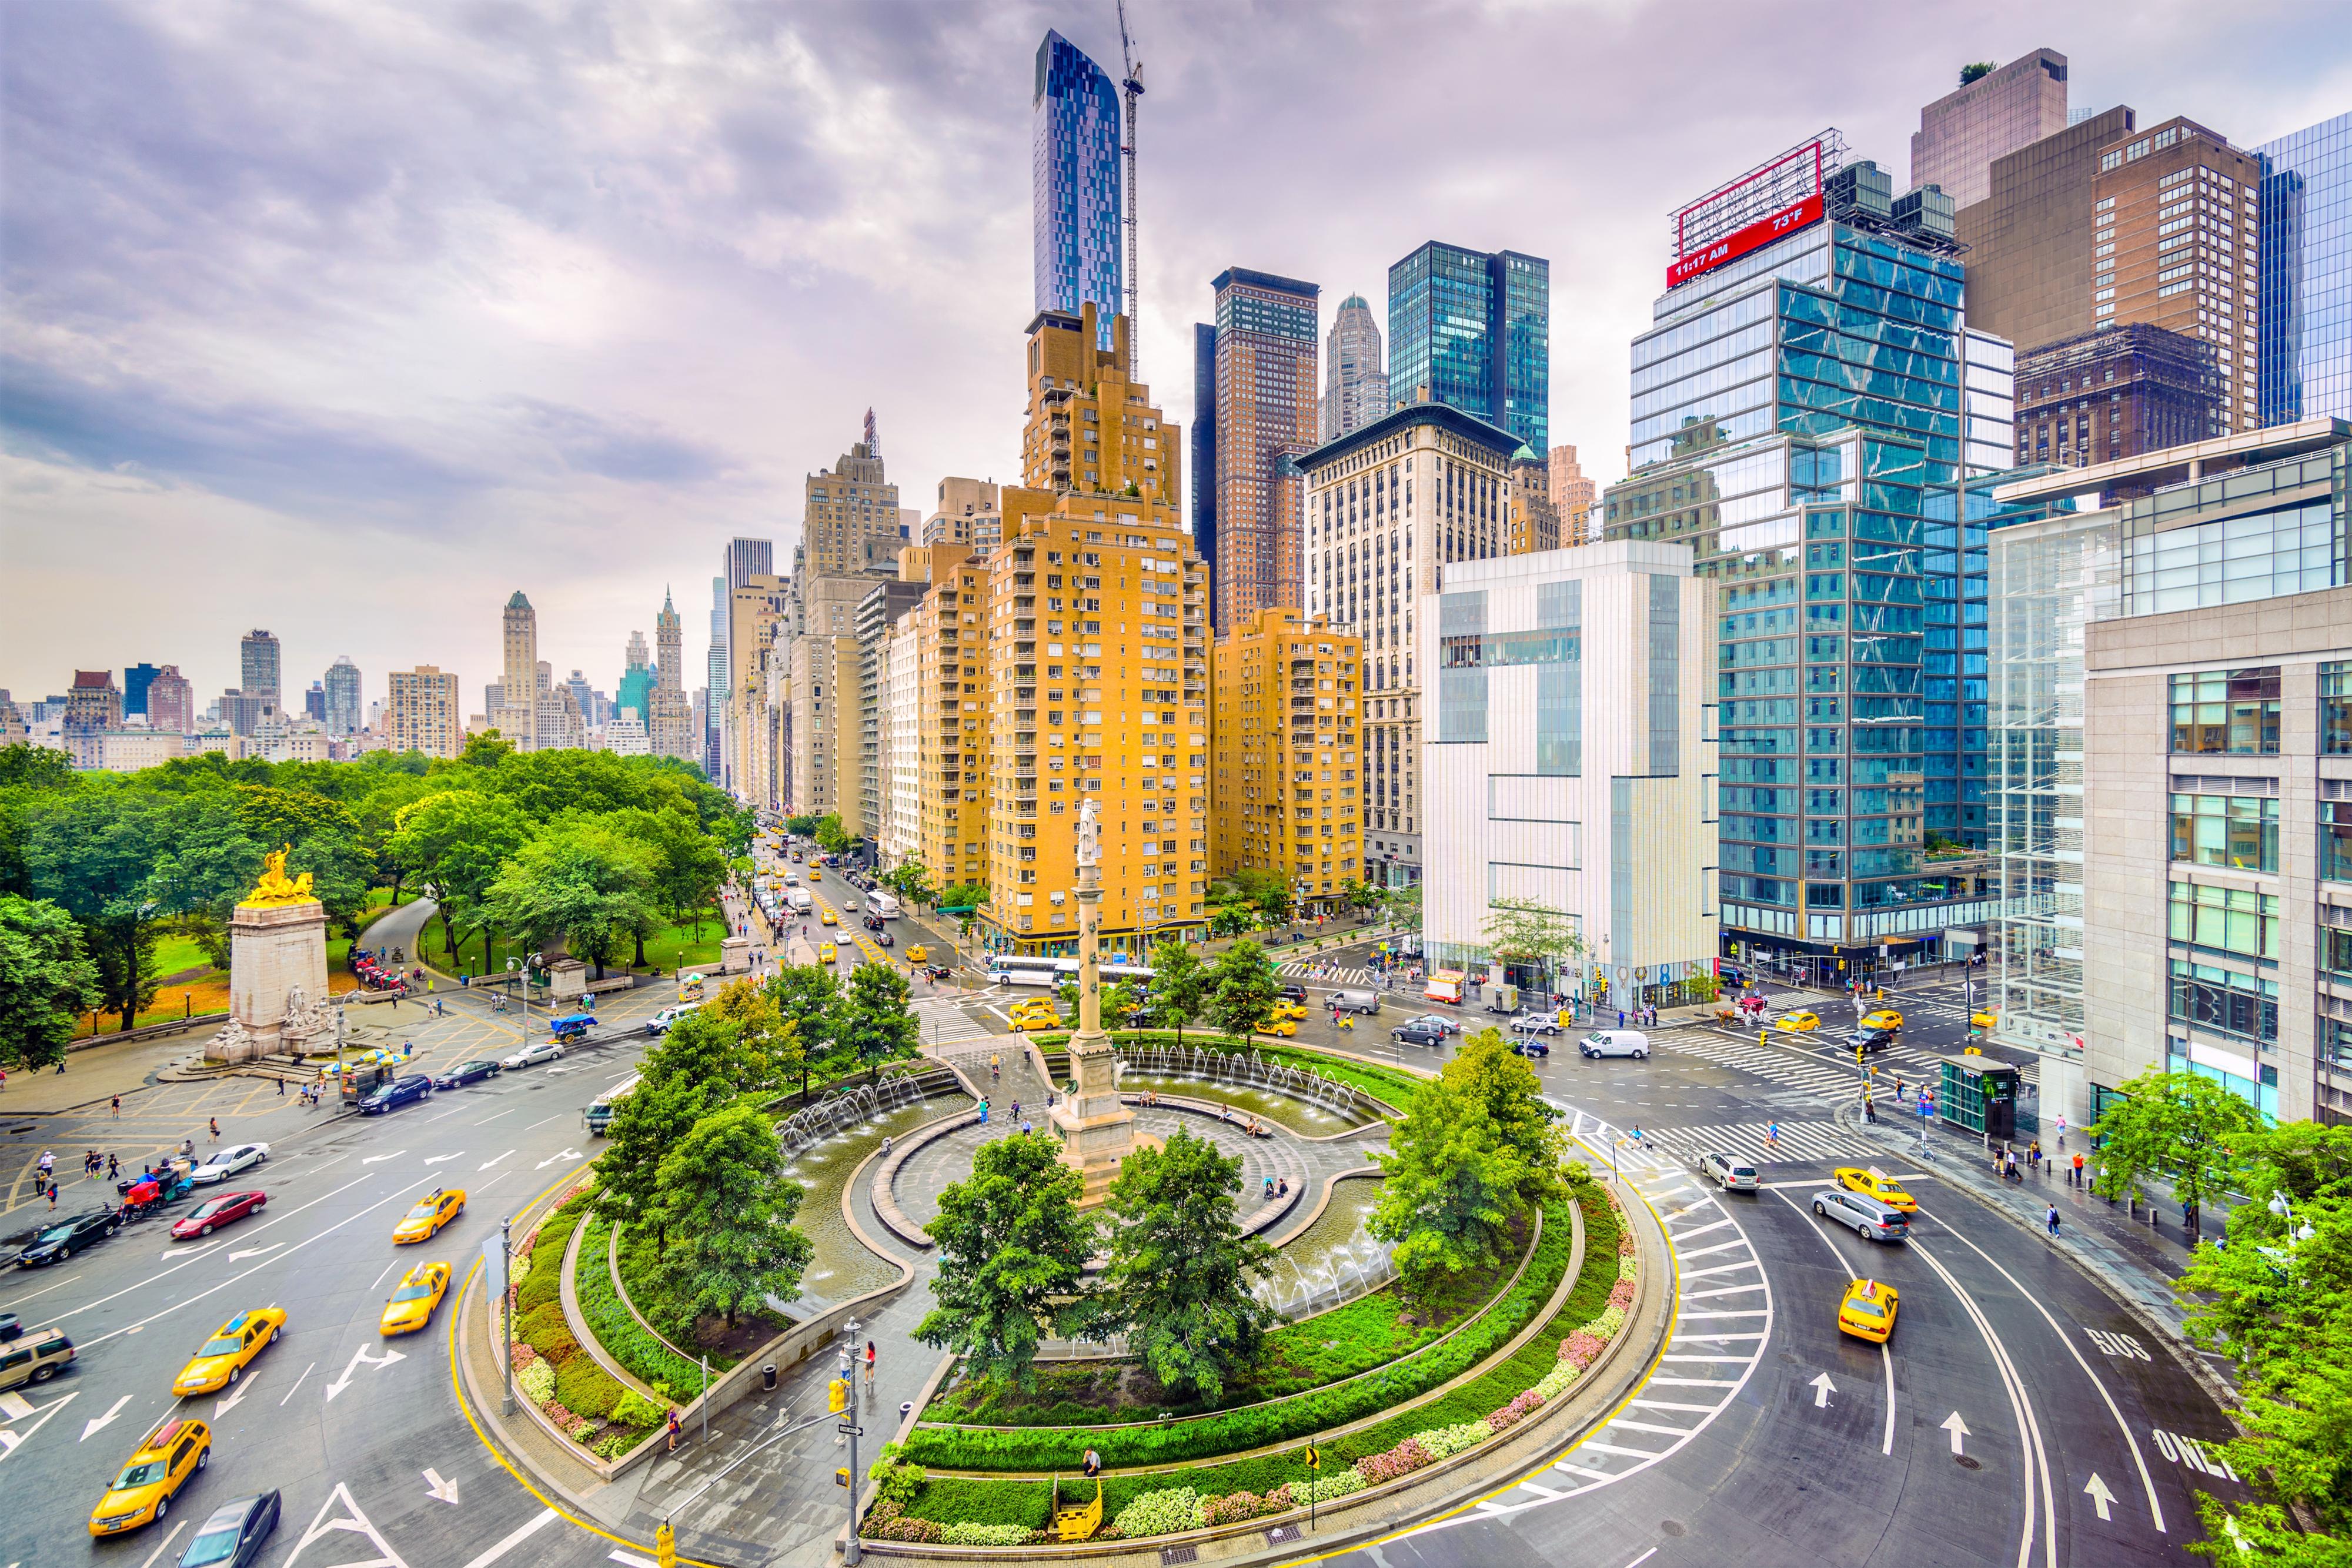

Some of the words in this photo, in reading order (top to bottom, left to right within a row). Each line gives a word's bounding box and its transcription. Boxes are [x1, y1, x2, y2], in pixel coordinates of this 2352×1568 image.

[1676, 254, 1706, 276] 11:17
[1709, 243, 1728, 261] AM
[1773, 208, 1802, 230] 73°F
[2083, 1327, 2152, 1362] BUS
